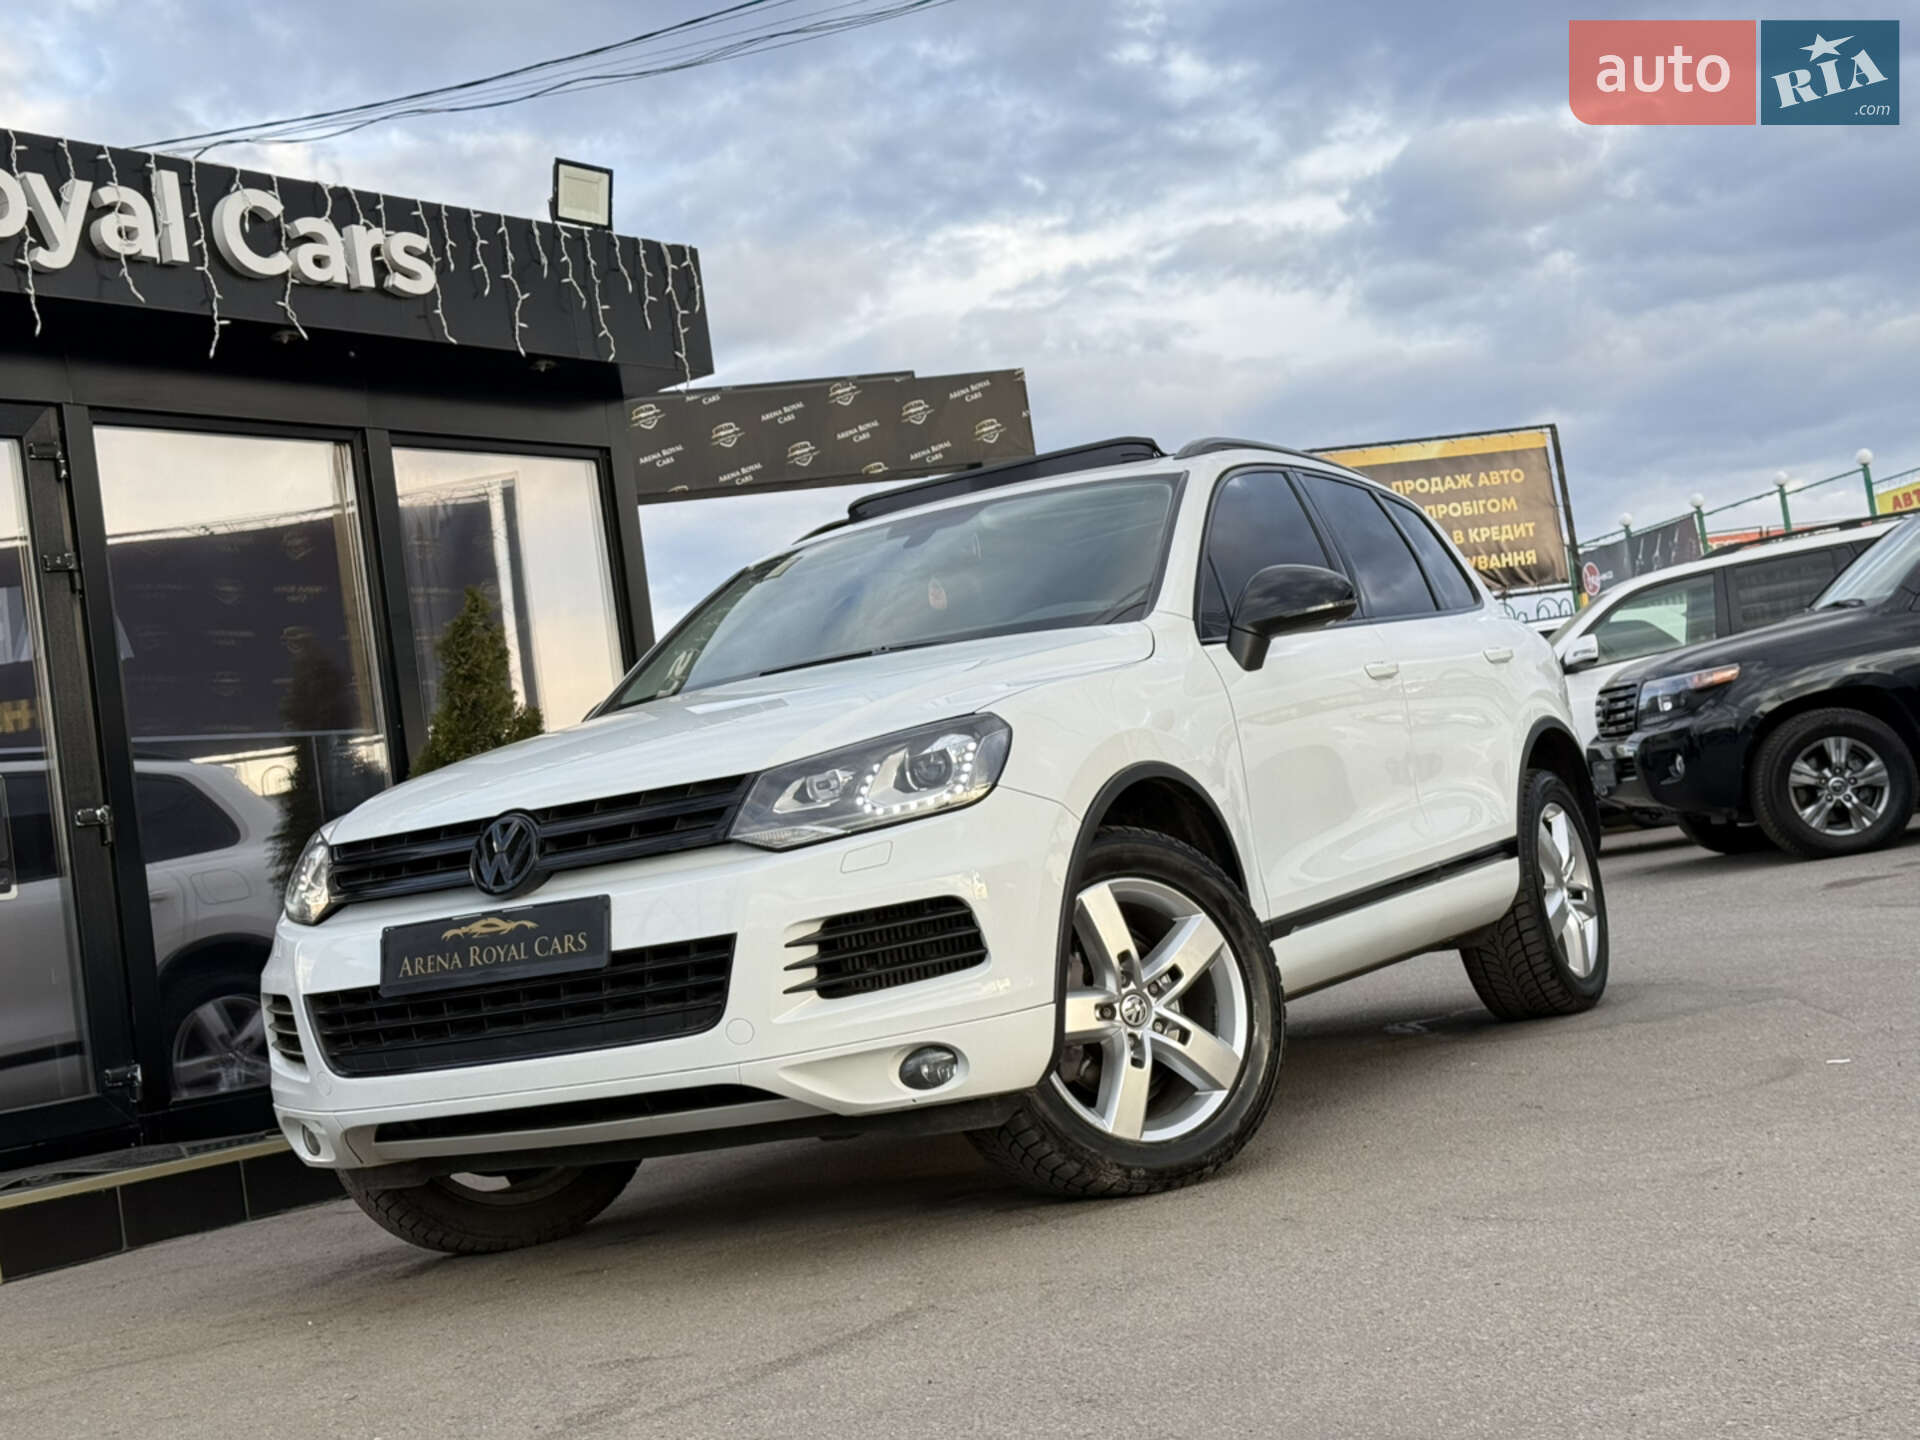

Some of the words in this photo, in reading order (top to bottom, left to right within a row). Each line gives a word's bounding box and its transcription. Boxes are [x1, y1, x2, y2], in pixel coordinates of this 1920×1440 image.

[212, 188, 437, 297] Cars
[1391, 473, 1473, 496] ПРОДАЖ
[1478, 468, 1525, 488] АВТО
[1423, 496, 1518, 519] ПРОБІГОМ
[1453, 530, 1465, 545] В
[1468, 522, 1536, 544] КРЕДИТ
[398, 952, 463, 978] ARENA
[469, 942, 528, 968] ROYAL
[534, 932, 588, 957] CARS
